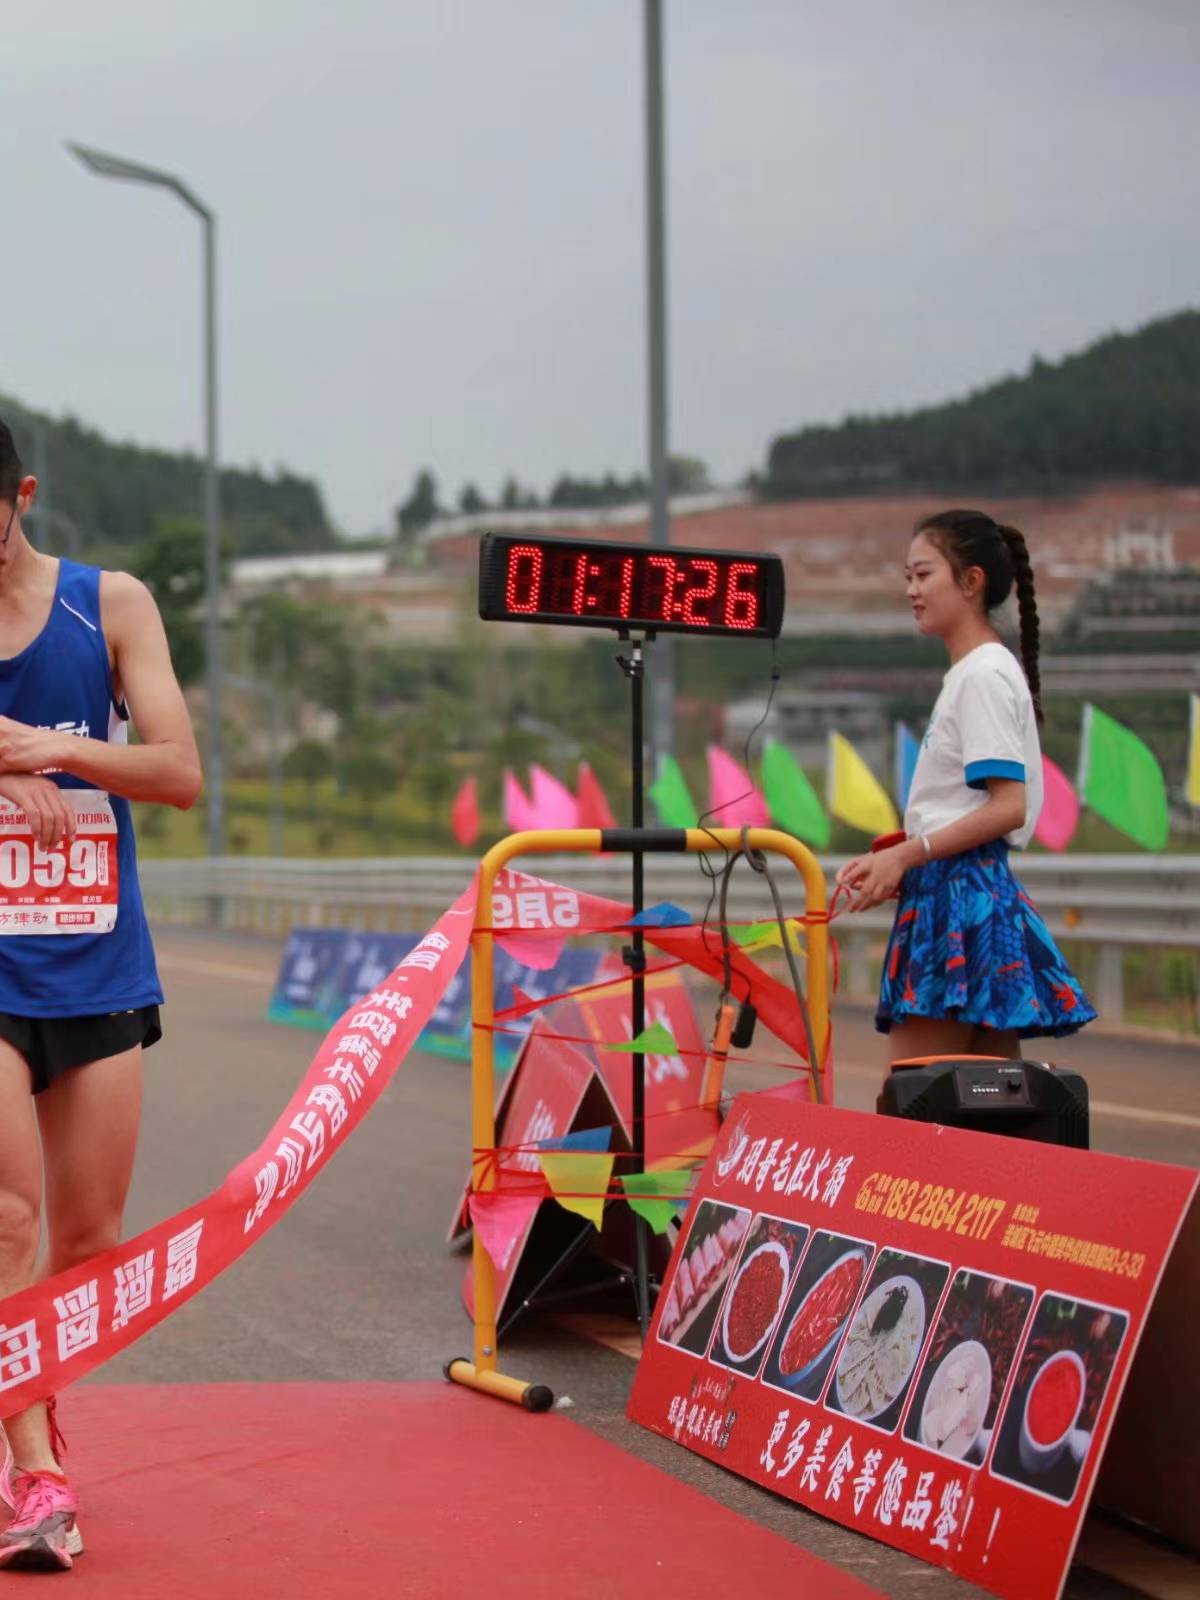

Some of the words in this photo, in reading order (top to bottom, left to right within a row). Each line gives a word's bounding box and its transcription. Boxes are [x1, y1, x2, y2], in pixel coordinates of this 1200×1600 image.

[505, 544, 758, 630] 01:17:26
[881, 1177, 920, 1221] 183
[908, 1183, 967, 1232] 2864
[955, 1193, 1007, 1241] 2117
